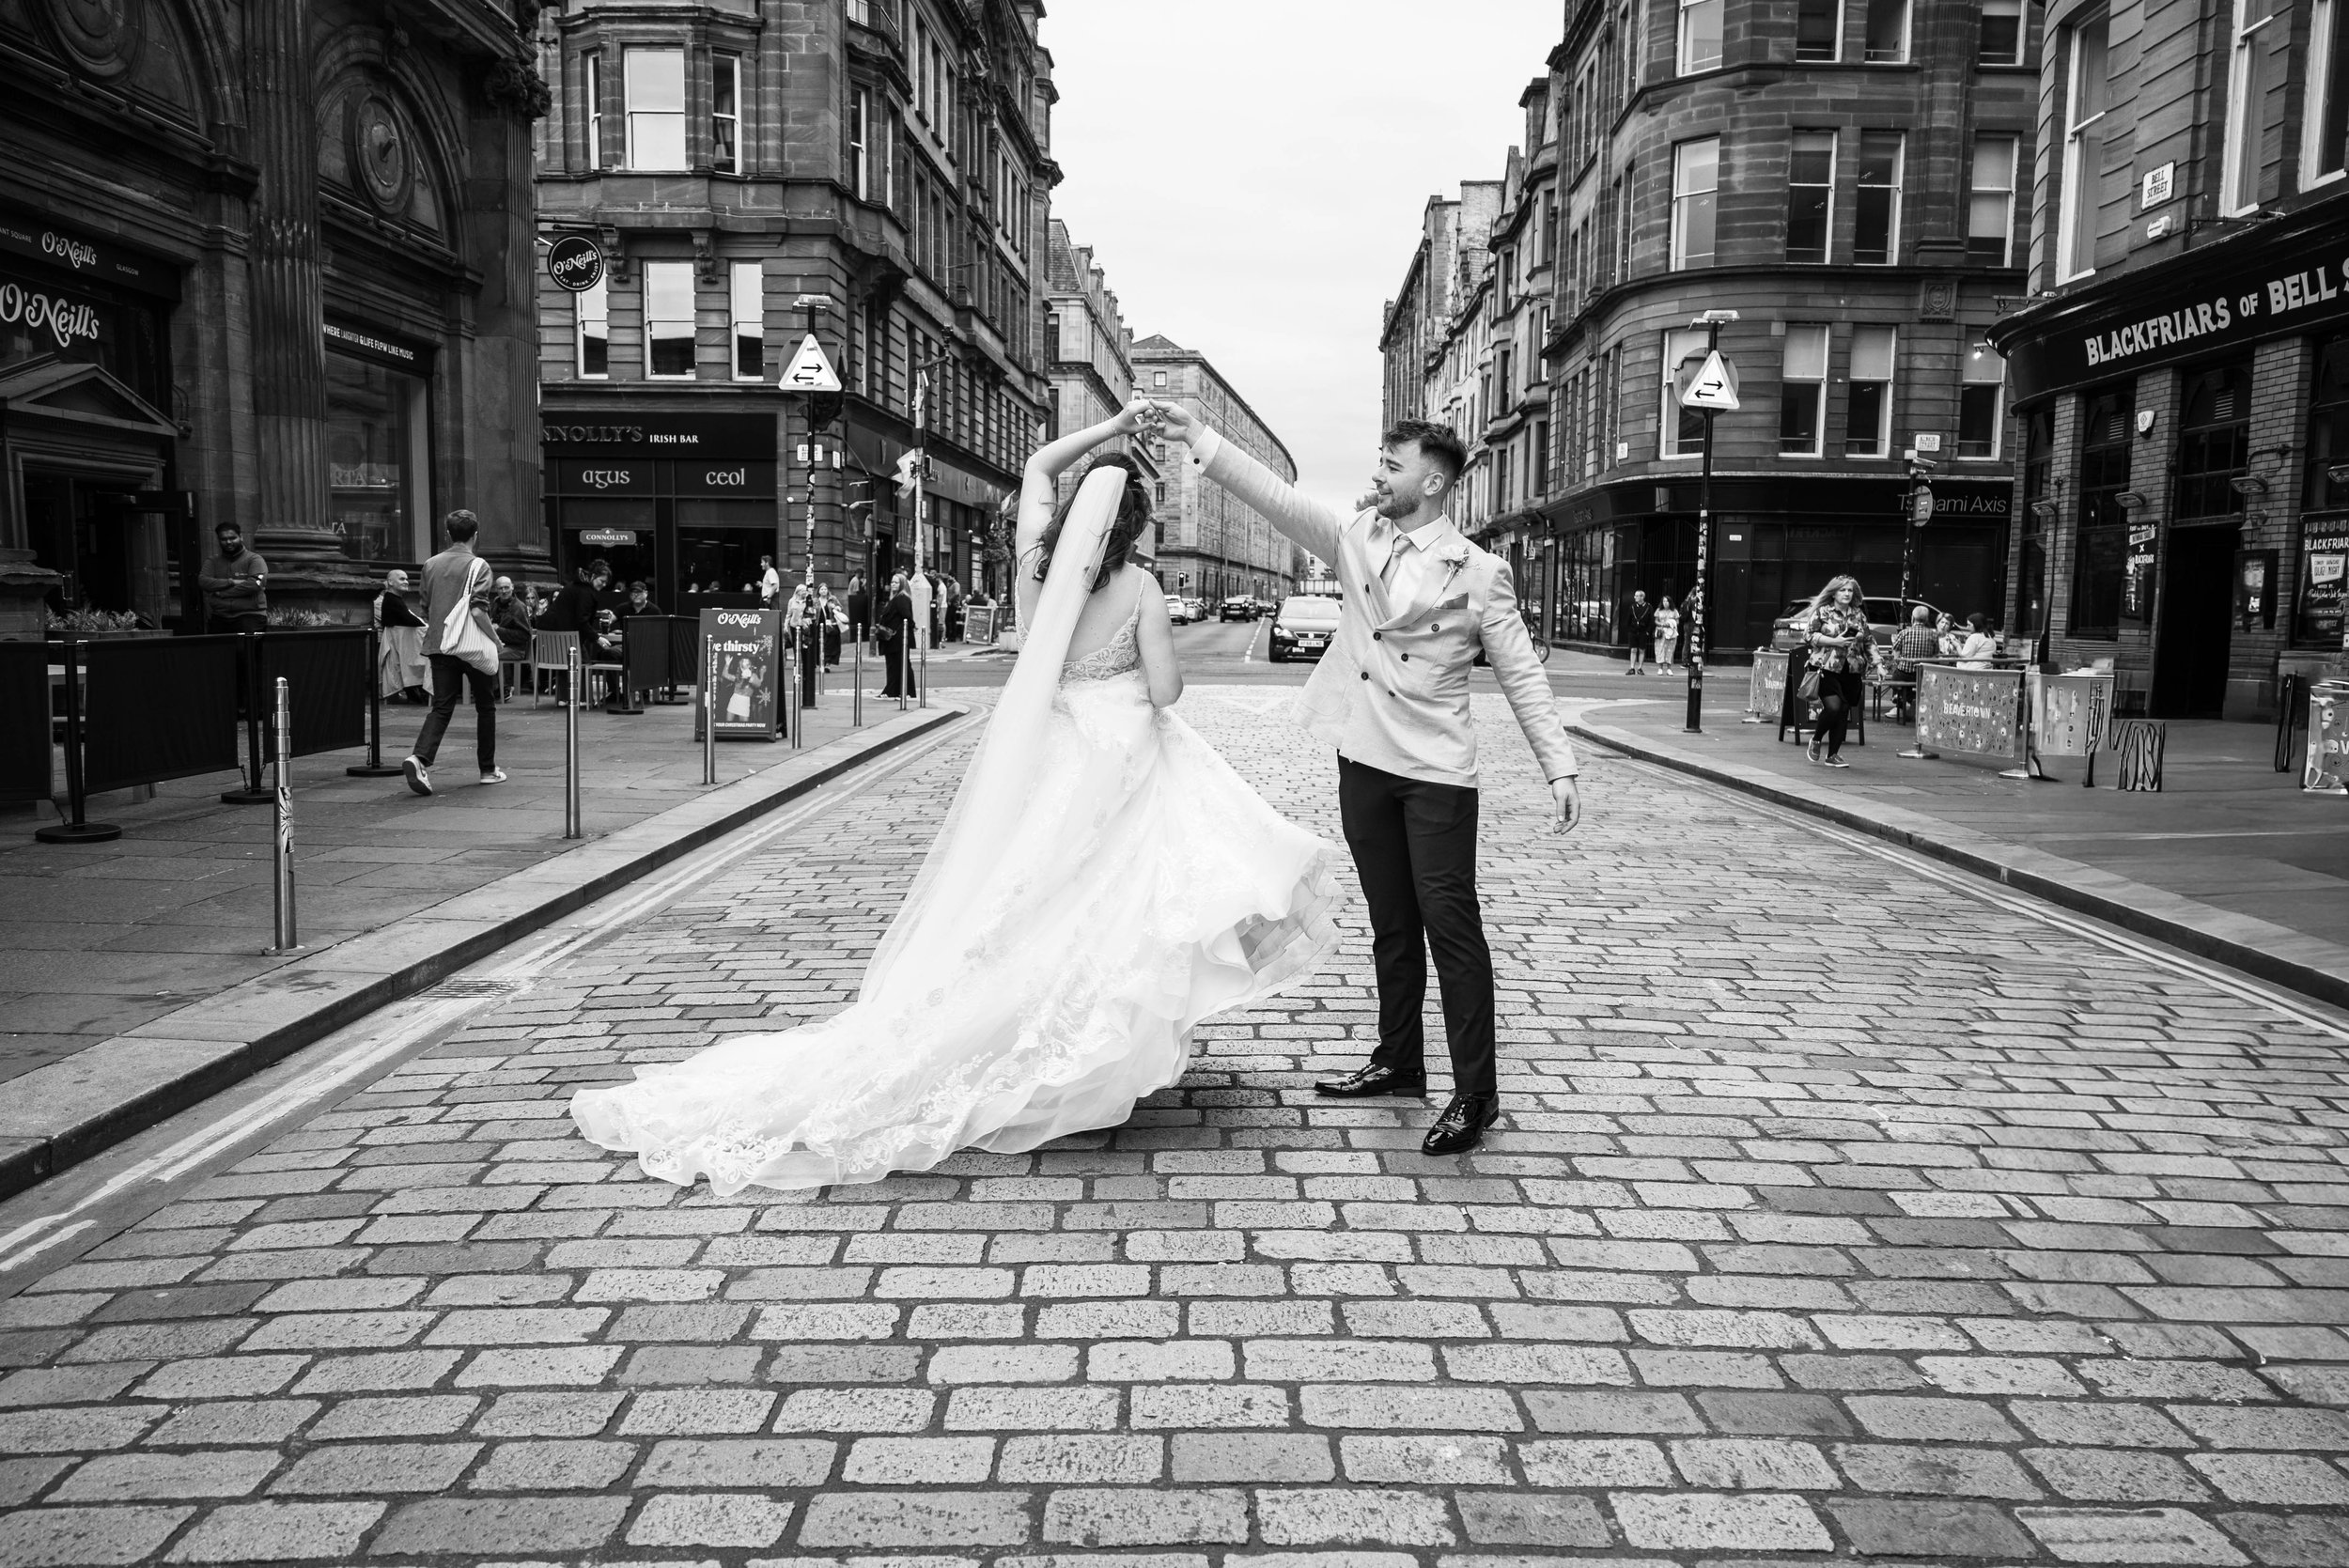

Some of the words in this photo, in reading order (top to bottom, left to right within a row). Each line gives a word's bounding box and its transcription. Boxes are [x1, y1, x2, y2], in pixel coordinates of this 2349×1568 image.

[2152, 170, 2165, 185] BELL
[2147, 180, 2169, 198] STREET
[11, 230, 32, 243] SQUARE
[42, 231, 97, 268] O'Neill's
[116, 263, 139, 276] GLASGOW
[553, 249, 598, 275] O'Neill's
[0, 283, 100, 348] O'Neill's
[2085, 297, 2231, 366] BLACKFRIARS
[2239, 292, 2259, 318] OF
[2267, 266, 2338, 316] BELL
[374, 339, 387, 352] FLOW
[388, 344, 398, 356] LIKE
[399, 348, 413, 361] MUSIC
[542, 426, 643, 442] NNOLLY'S
[649, 434, 677, 443] IRISH
[679, 434, 699, 443] BAR
[583, 470, 630, 489] agus
[706, 468, 745, 486] ceol
[1969, 495, 2007, 513] Axis
[2327, 566, 2340, 575] NIGHT
[717, 613, 762, 629] O'Neill's
[723, 640, 760, 655] thirsty
[1943, 701, 1991, 720] BEAVERTOWN
